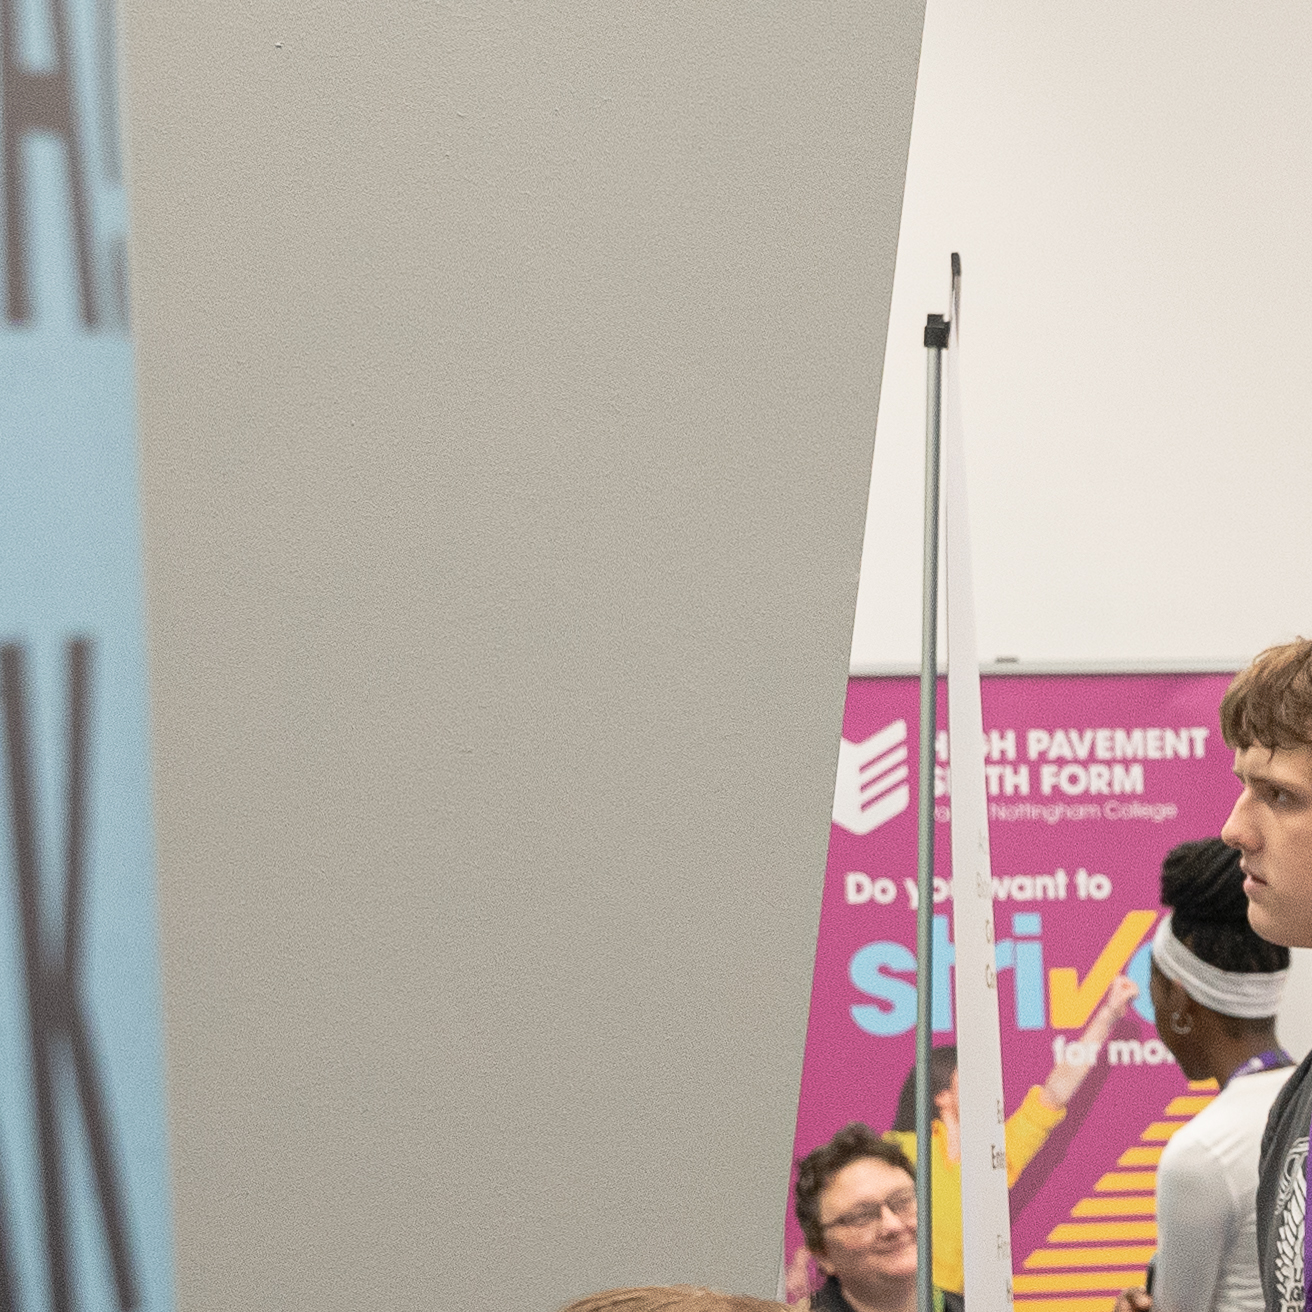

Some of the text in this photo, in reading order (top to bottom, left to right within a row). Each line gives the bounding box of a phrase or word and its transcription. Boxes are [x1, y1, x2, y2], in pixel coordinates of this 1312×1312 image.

[1027, 727, 1209, 760] PAVEMENT
[1041, 763, 1144, 796] FORM
[1104, 800, 1178, 822] College
[845, 871, 897, 904] Do
[1075, 868, 1112, 900] to
[1054, 1035, 1100, 1066] for
